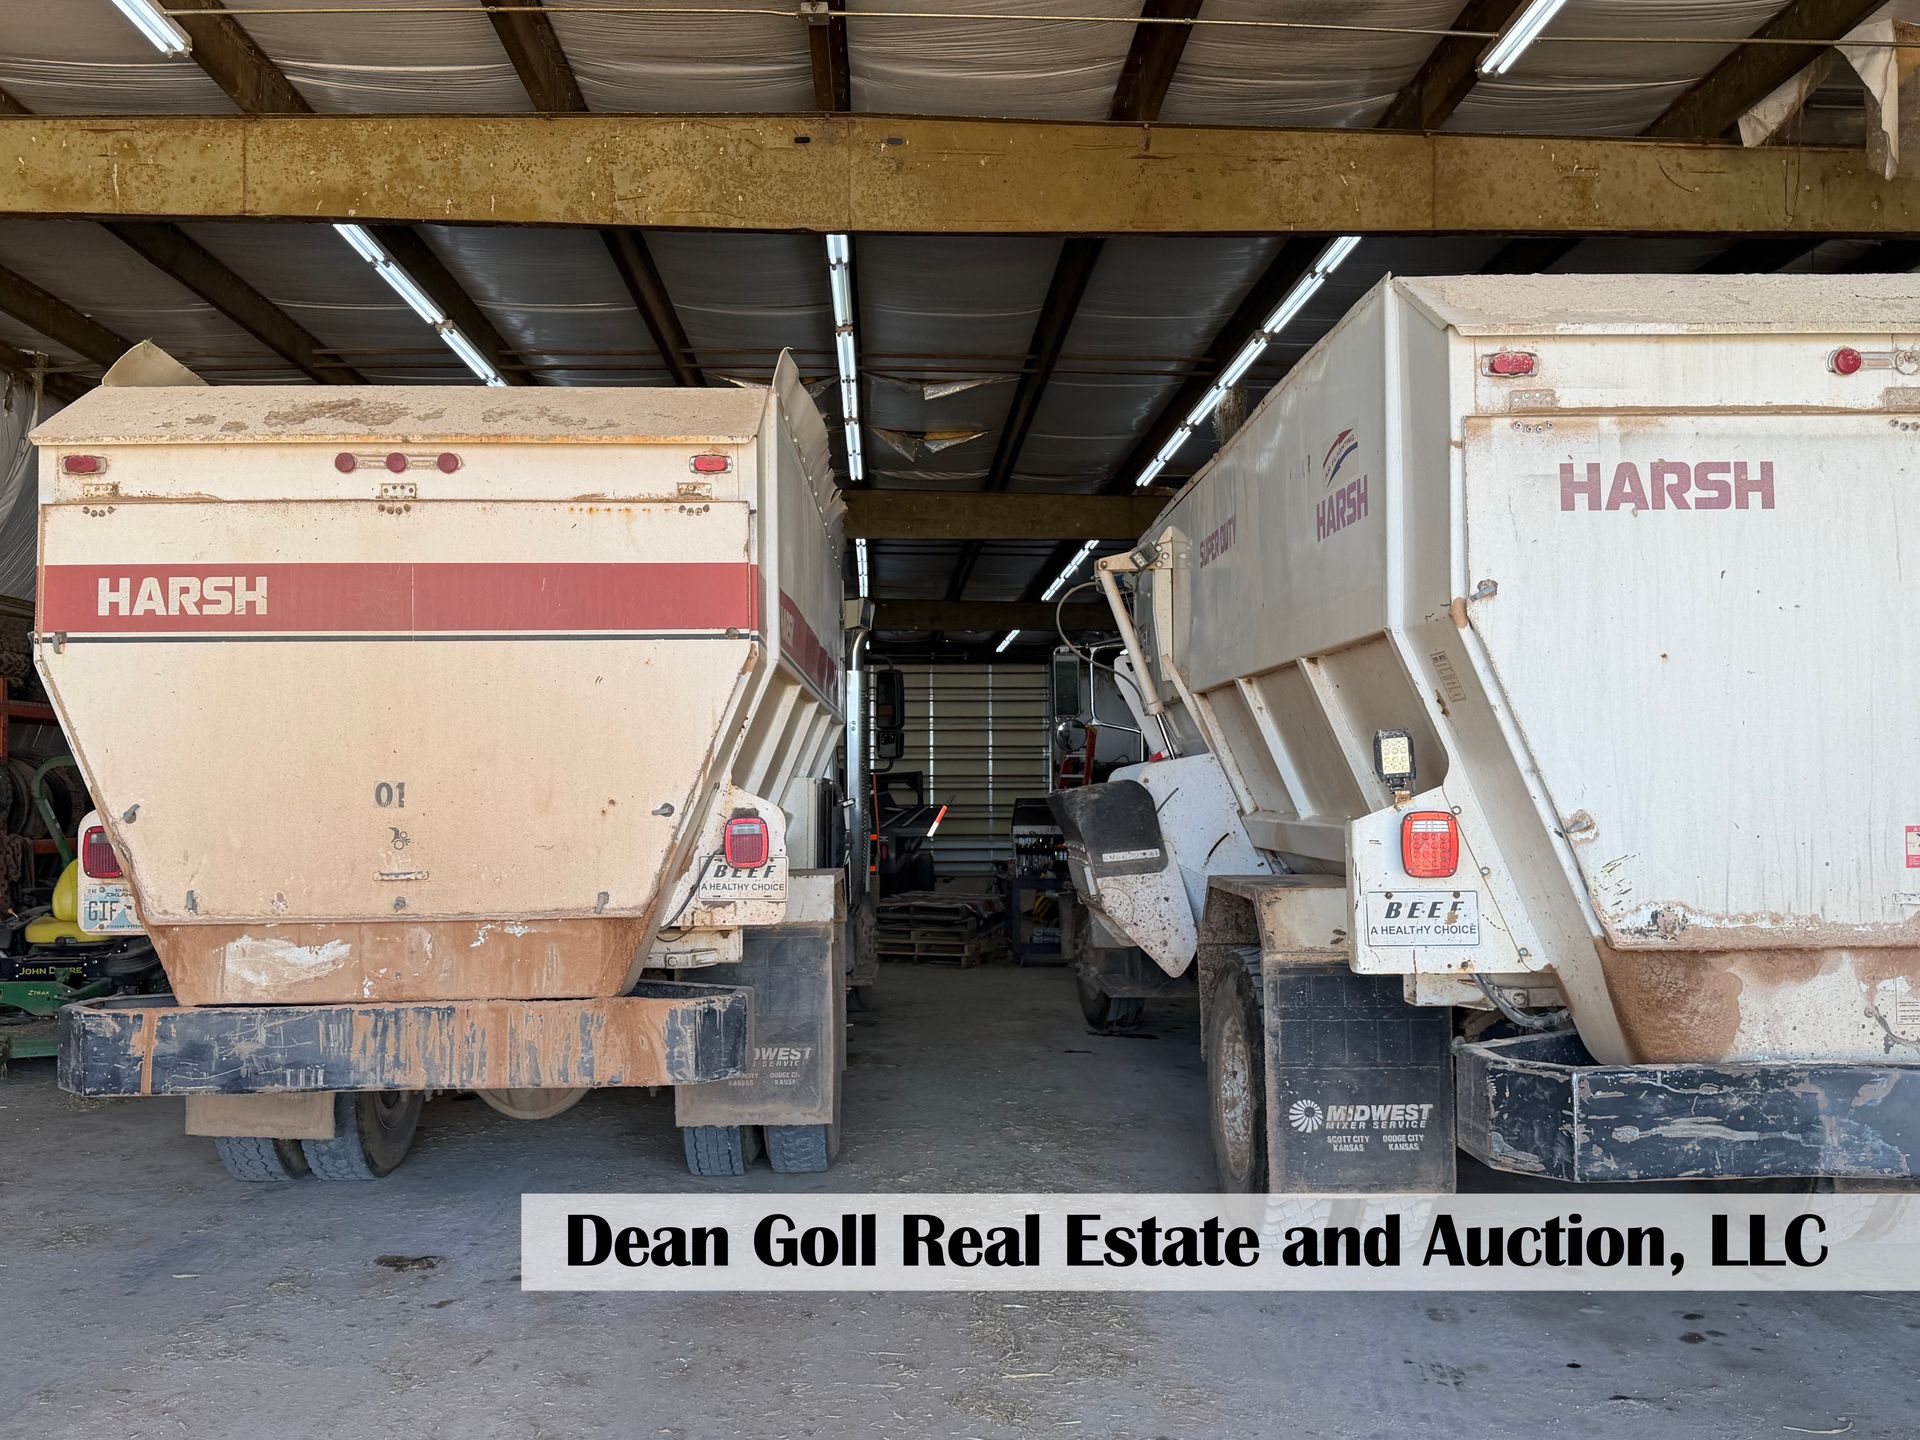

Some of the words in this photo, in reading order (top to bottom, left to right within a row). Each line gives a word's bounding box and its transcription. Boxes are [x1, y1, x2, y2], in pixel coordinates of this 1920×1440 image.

[1559, 461, 1775, 511] HARSH
[1316, 474, 1368, 543] HARSH
[1200, 529, 1219, 569] SUPER
[1220, 513, 1236, 555] DUTY
[97, 576, 267, 616] HARSH
[375, 782, 405, 808] 01
[713, 865, 776, 878] BEEF
[709, 883, 749, 891] HEALTHY
[751, 883, 785, 891] CHOICE
[1385, 901, 1465, 919] BEEF
[1370, 926, 1379, 935] A
[1381, 925, 1431, 935] HEALTHY
[1434, 925, 1477, 934] CHOICE
[19, 967, 47, 975] JOHN
[49, 966, 83, 975] DRE
[1326, 1104, 1433, 1121] MIDWEST
[1326, 1121, 1366, 1129] MIXER
[1372, 1120, 1427, 1129] SERVICE
[1327, 1135, 1351, 1143] SCOTT
[1352, 1135, 1370, 1143] CITY
[1382, 1135, 1407, 1143] DODGE
[1407, 1134, 1425, 1142] CITY
[1333, 1144, 1365, 1152] KANSAS
[1388, 1143, 1420, 1151] KANSAS
